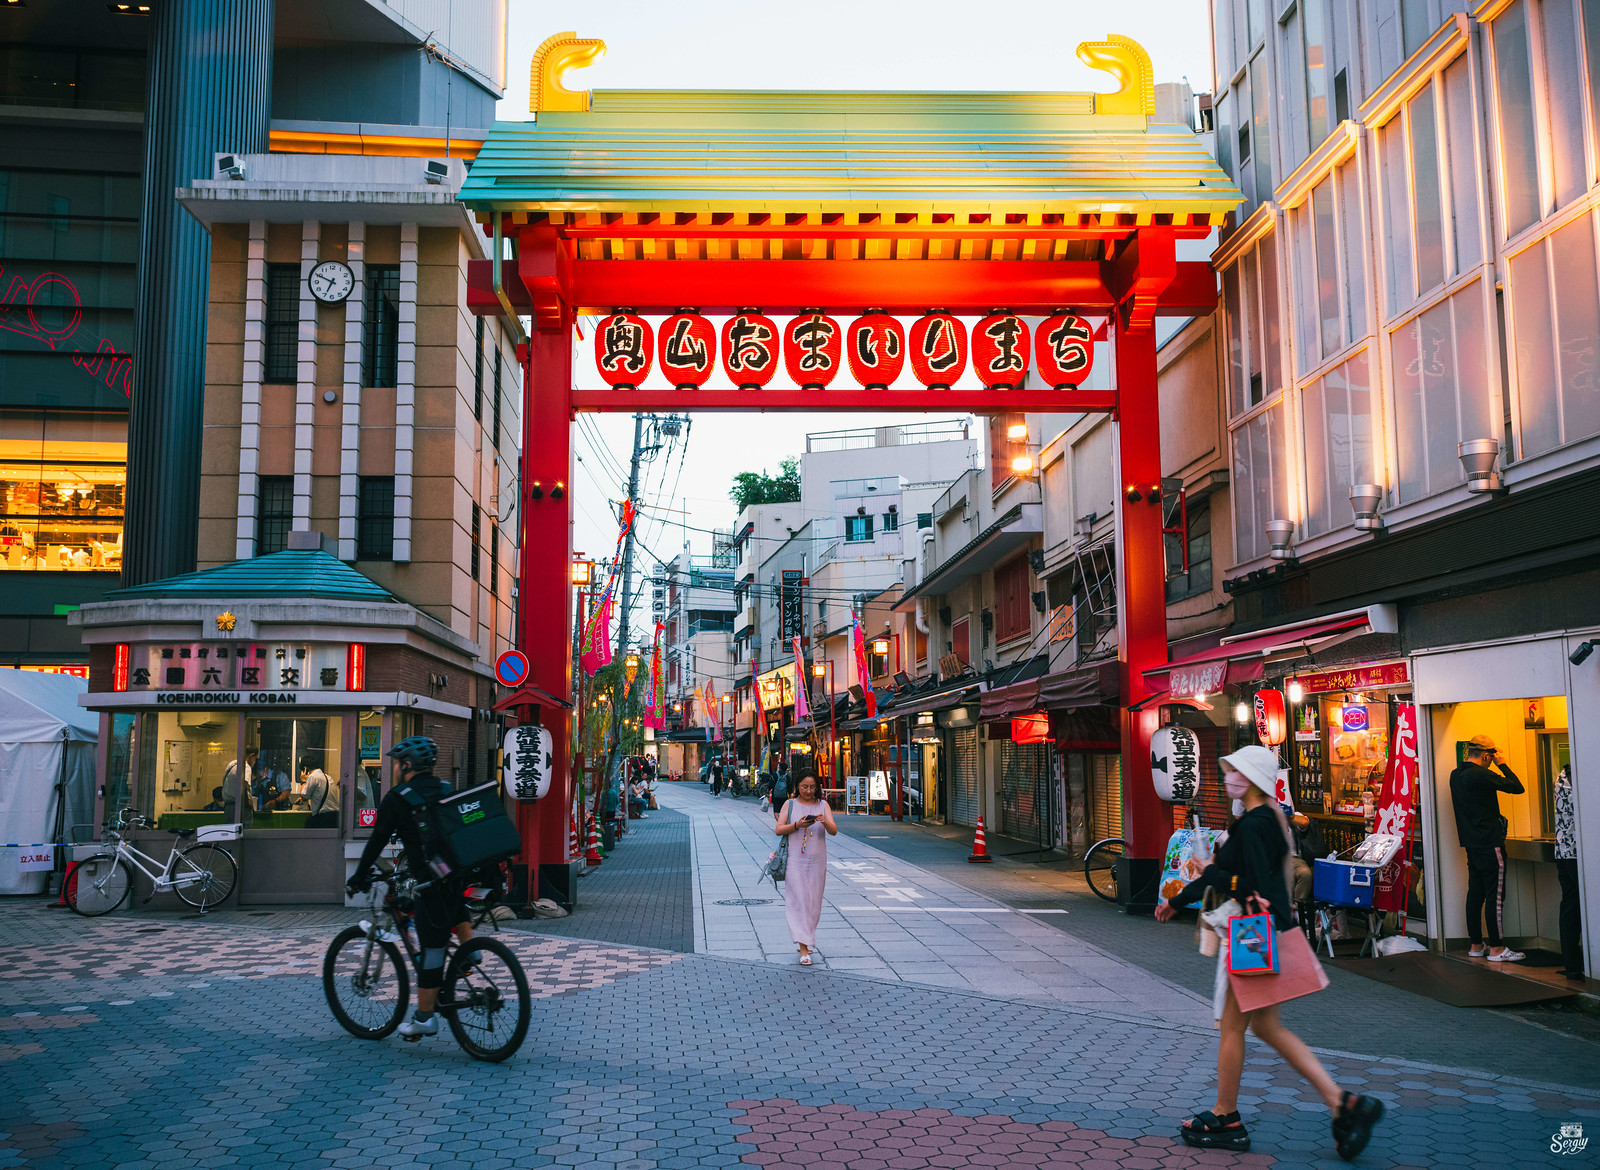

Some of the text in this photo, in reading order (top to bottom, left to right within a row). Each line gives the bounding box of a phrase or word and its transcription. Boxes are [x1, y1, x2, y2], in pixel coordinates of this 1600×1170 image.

[602, 316, 1090, 372] 奥山おまいりまち
[157, 693, 297, 704] KOENROKKU KOBAN
[1343, 712, 1366, 724] OPEN
[515, 726, 542, 798] 浅草寺参道
[1170, 728, 1196, 800] 浅草寺参道
[457, 799, 482, 815] Uber
[461, 810, 486, 824] Eats
[20, 854, 51, 864] 立入禁止
